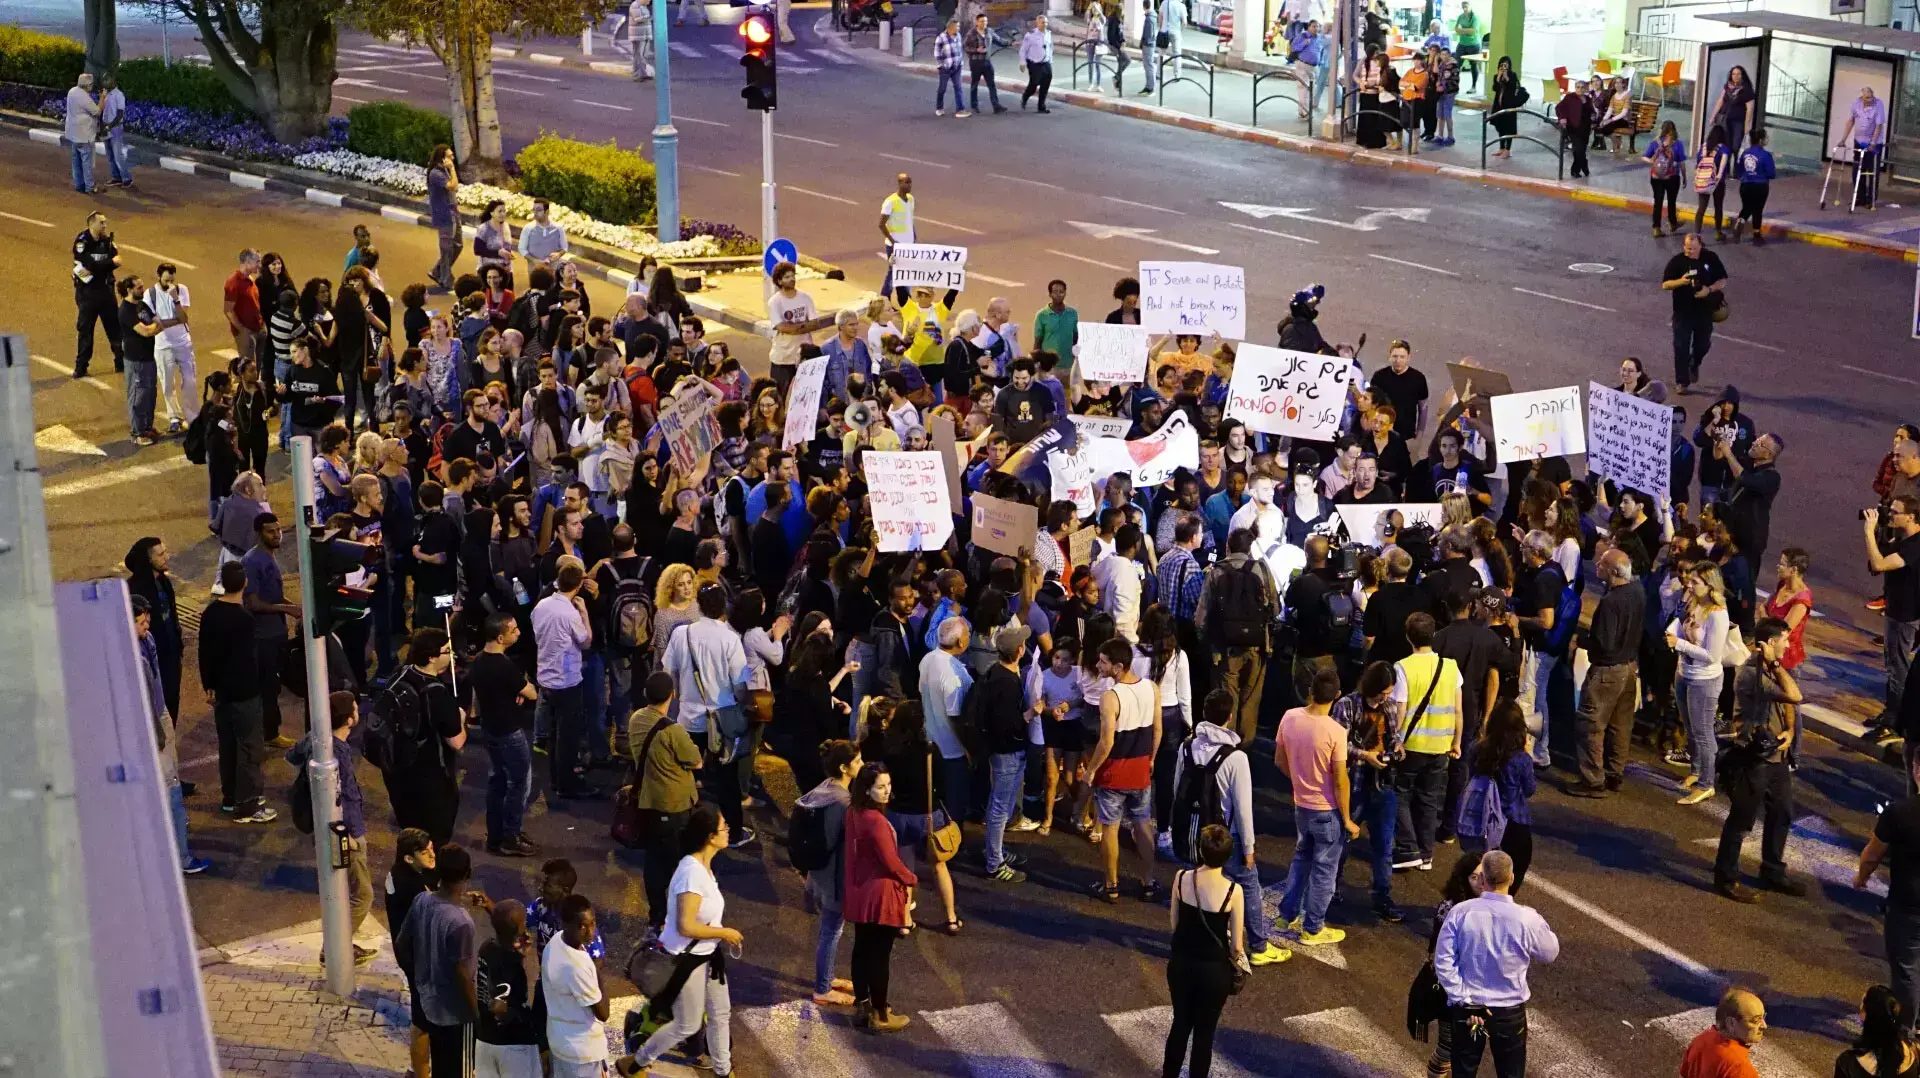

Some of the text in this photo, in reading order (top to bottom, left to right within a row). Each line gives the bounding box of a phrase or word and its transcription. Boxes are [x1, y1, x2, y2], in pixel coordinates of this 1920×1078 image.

[894, 248, 962, 262] לא לגזענות
[895, 269, 962, 286] כן לאחדות
[1141, 268, 1160, 287] To
[1163, 269, 1192, 286] Serve
[1146, 296, 1163, 311] And
[1170, 296, 1185, 309] not
[1222, 304, 1238, 320] my
[1281, 356, 1348, 383] גם אני
[1257, 375, 1320, 399] גם אתה
[661, 410, 684, 435] ONE
[1138, 469, 1149, 482] 6
[494, 982, 512, 1004] 2
